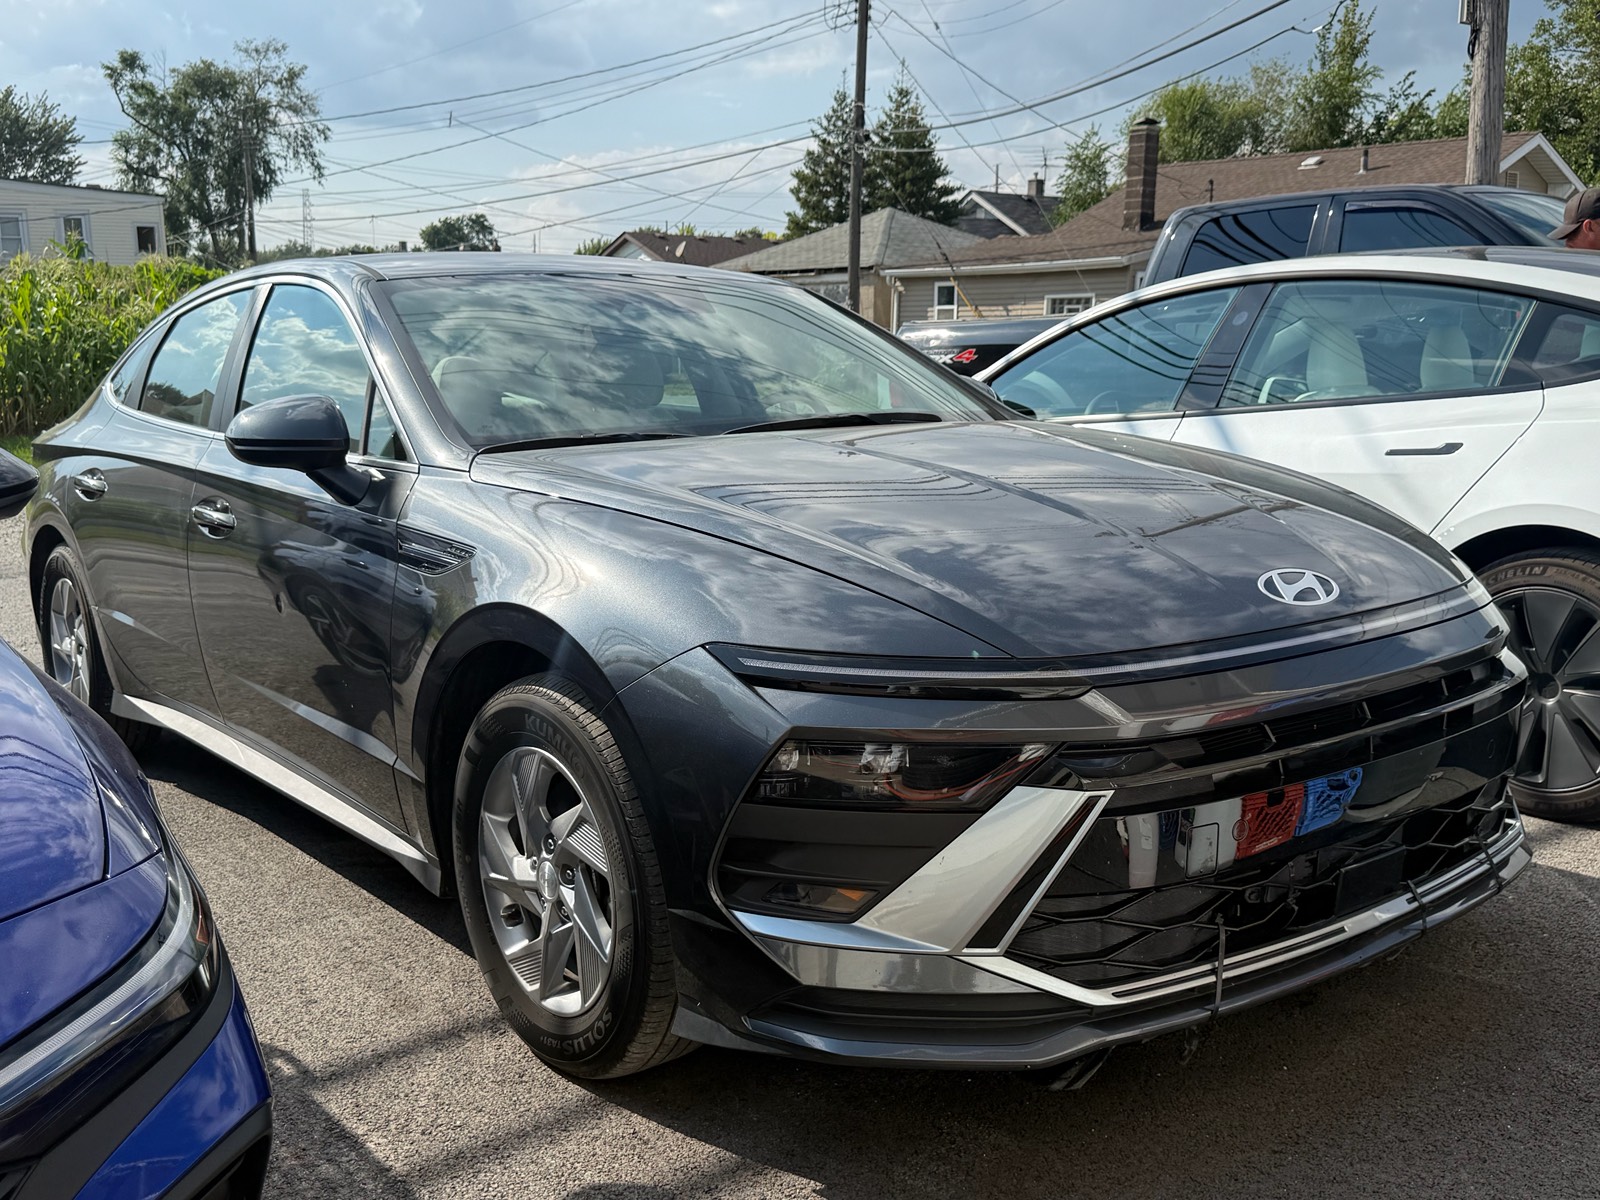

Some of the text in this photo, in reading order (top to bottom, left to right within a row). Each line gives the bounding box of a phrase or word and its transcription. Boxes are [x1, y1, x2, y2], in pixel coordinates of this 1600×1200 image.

[1484, 565, 1543, 584] CHELIN
[524, 713, 585, 779] KUMHO
[562, 1006, 613, 1055] SOLUS
